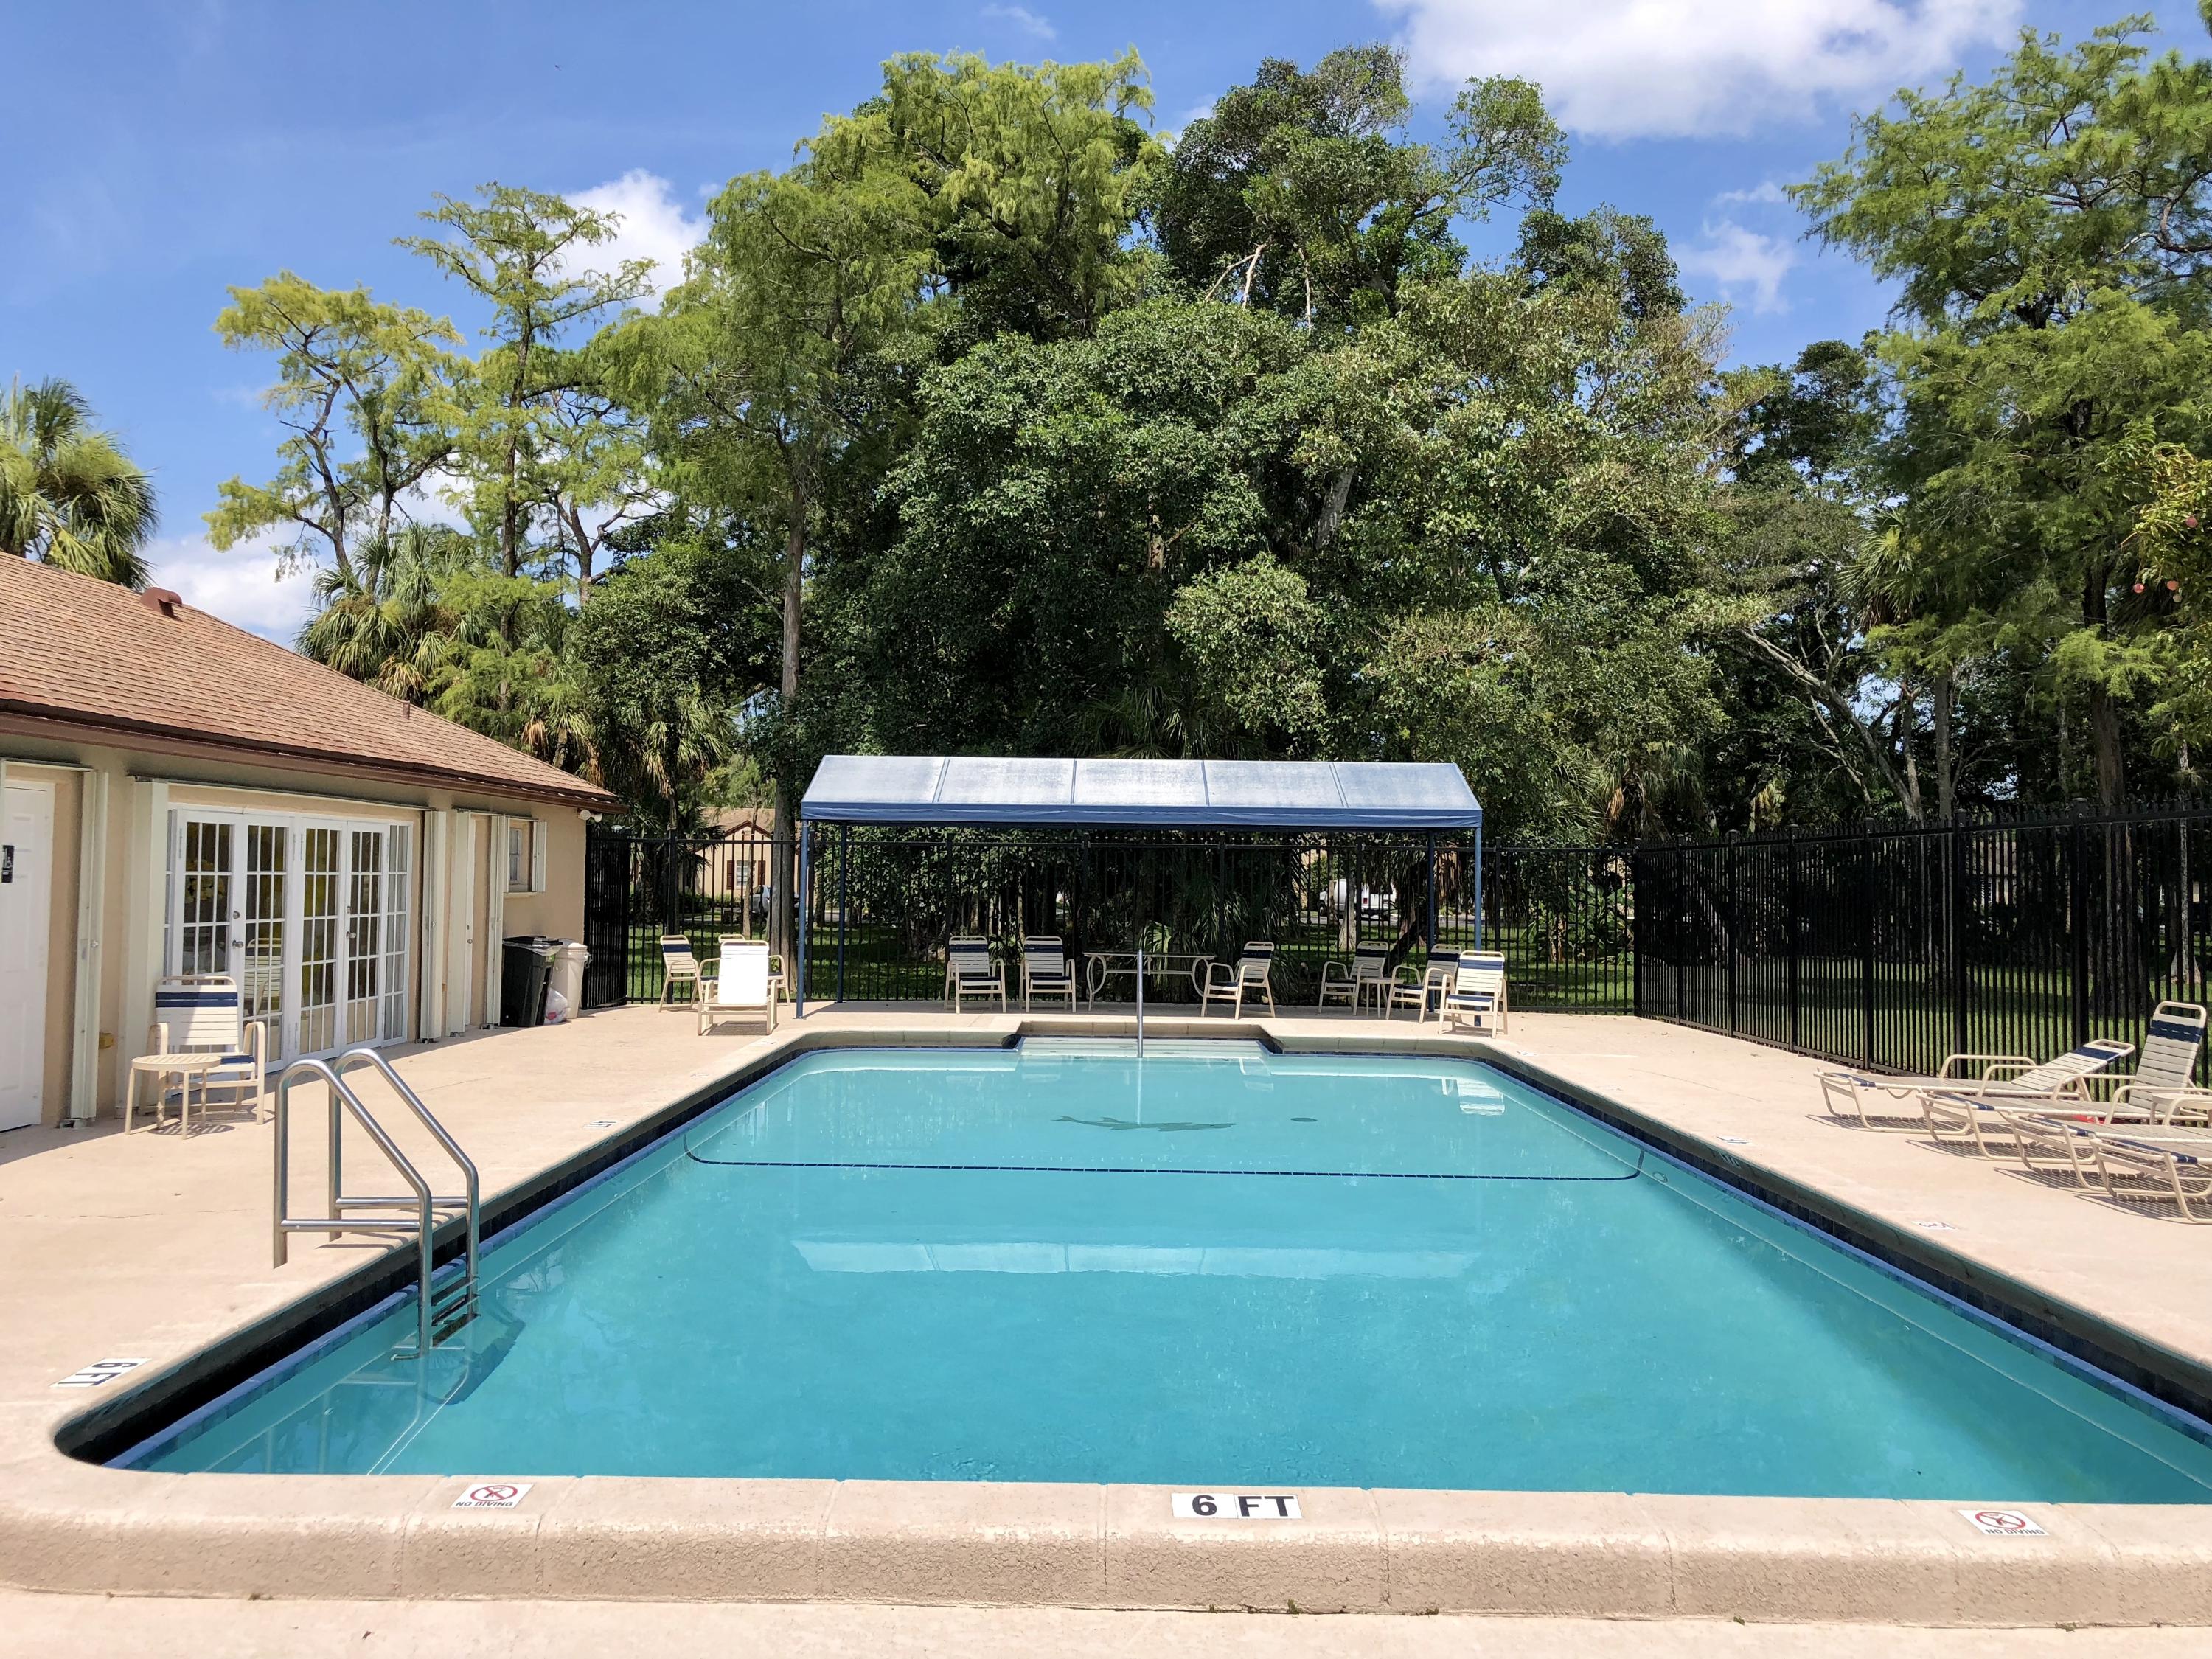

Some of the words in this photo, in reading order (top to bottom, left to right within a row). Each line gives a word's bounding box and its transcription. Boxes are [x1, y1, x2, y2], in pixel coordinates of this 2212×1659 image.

[58, 1372, 122, 1387] FT
[1192, 1495, 1217, 1516] 6
[1237, 1495, 1294, 1517] FT
